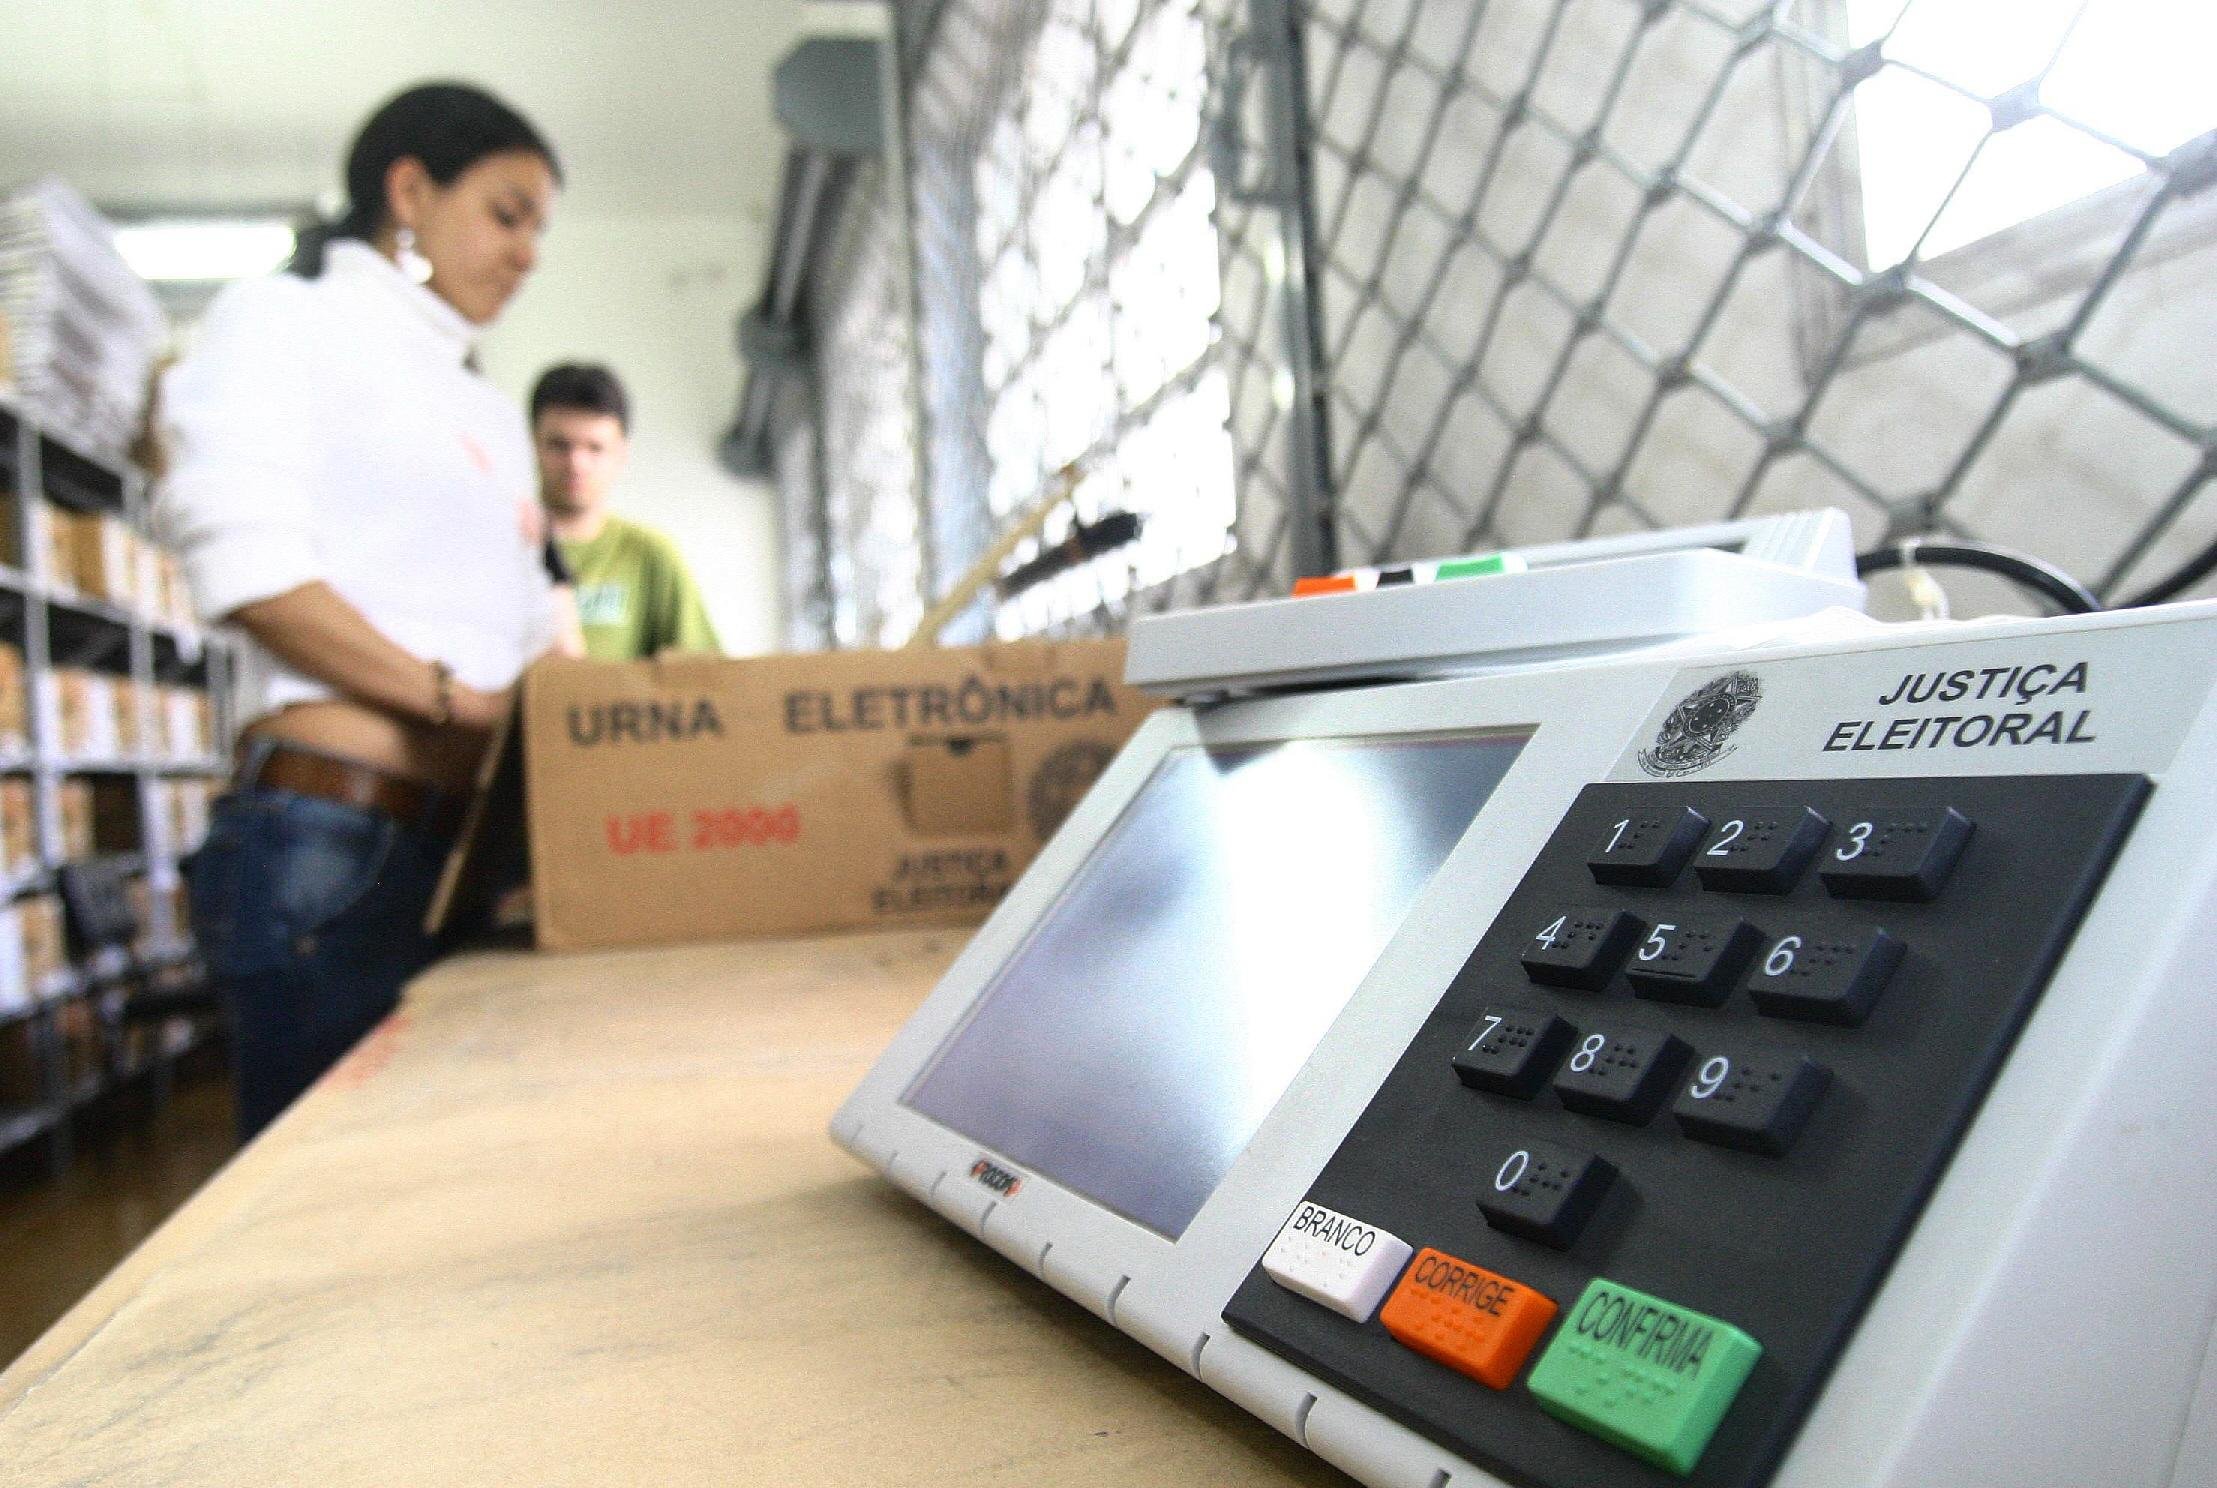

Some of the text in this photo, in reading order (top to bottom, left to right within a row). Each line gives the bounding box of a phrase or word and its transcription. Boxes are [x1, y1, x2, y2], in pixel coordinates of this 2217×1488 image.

[1879, 662, 2088, 706] JUSTIÇA
[567, 675, 1117, 746] URNA ELETRÔNICA
[1822, 710, 2095, 752] ELEITORAL
[607, 811, 677, 856] UE
[1605, 819, 1872, 861] 1 2 3
[1535, 916, 1802, 976] 4 5 6
[1468, 1016, 1729, 1099] 7 8 9
[1495, 1151, 1530, 1191] 0
[1293, 1206, 1376, 1257] BRANCO
[1415, 1256, 1514, 1318] CORRIGE
[1576, 1292, 1713, 1379] CONFIRMA
